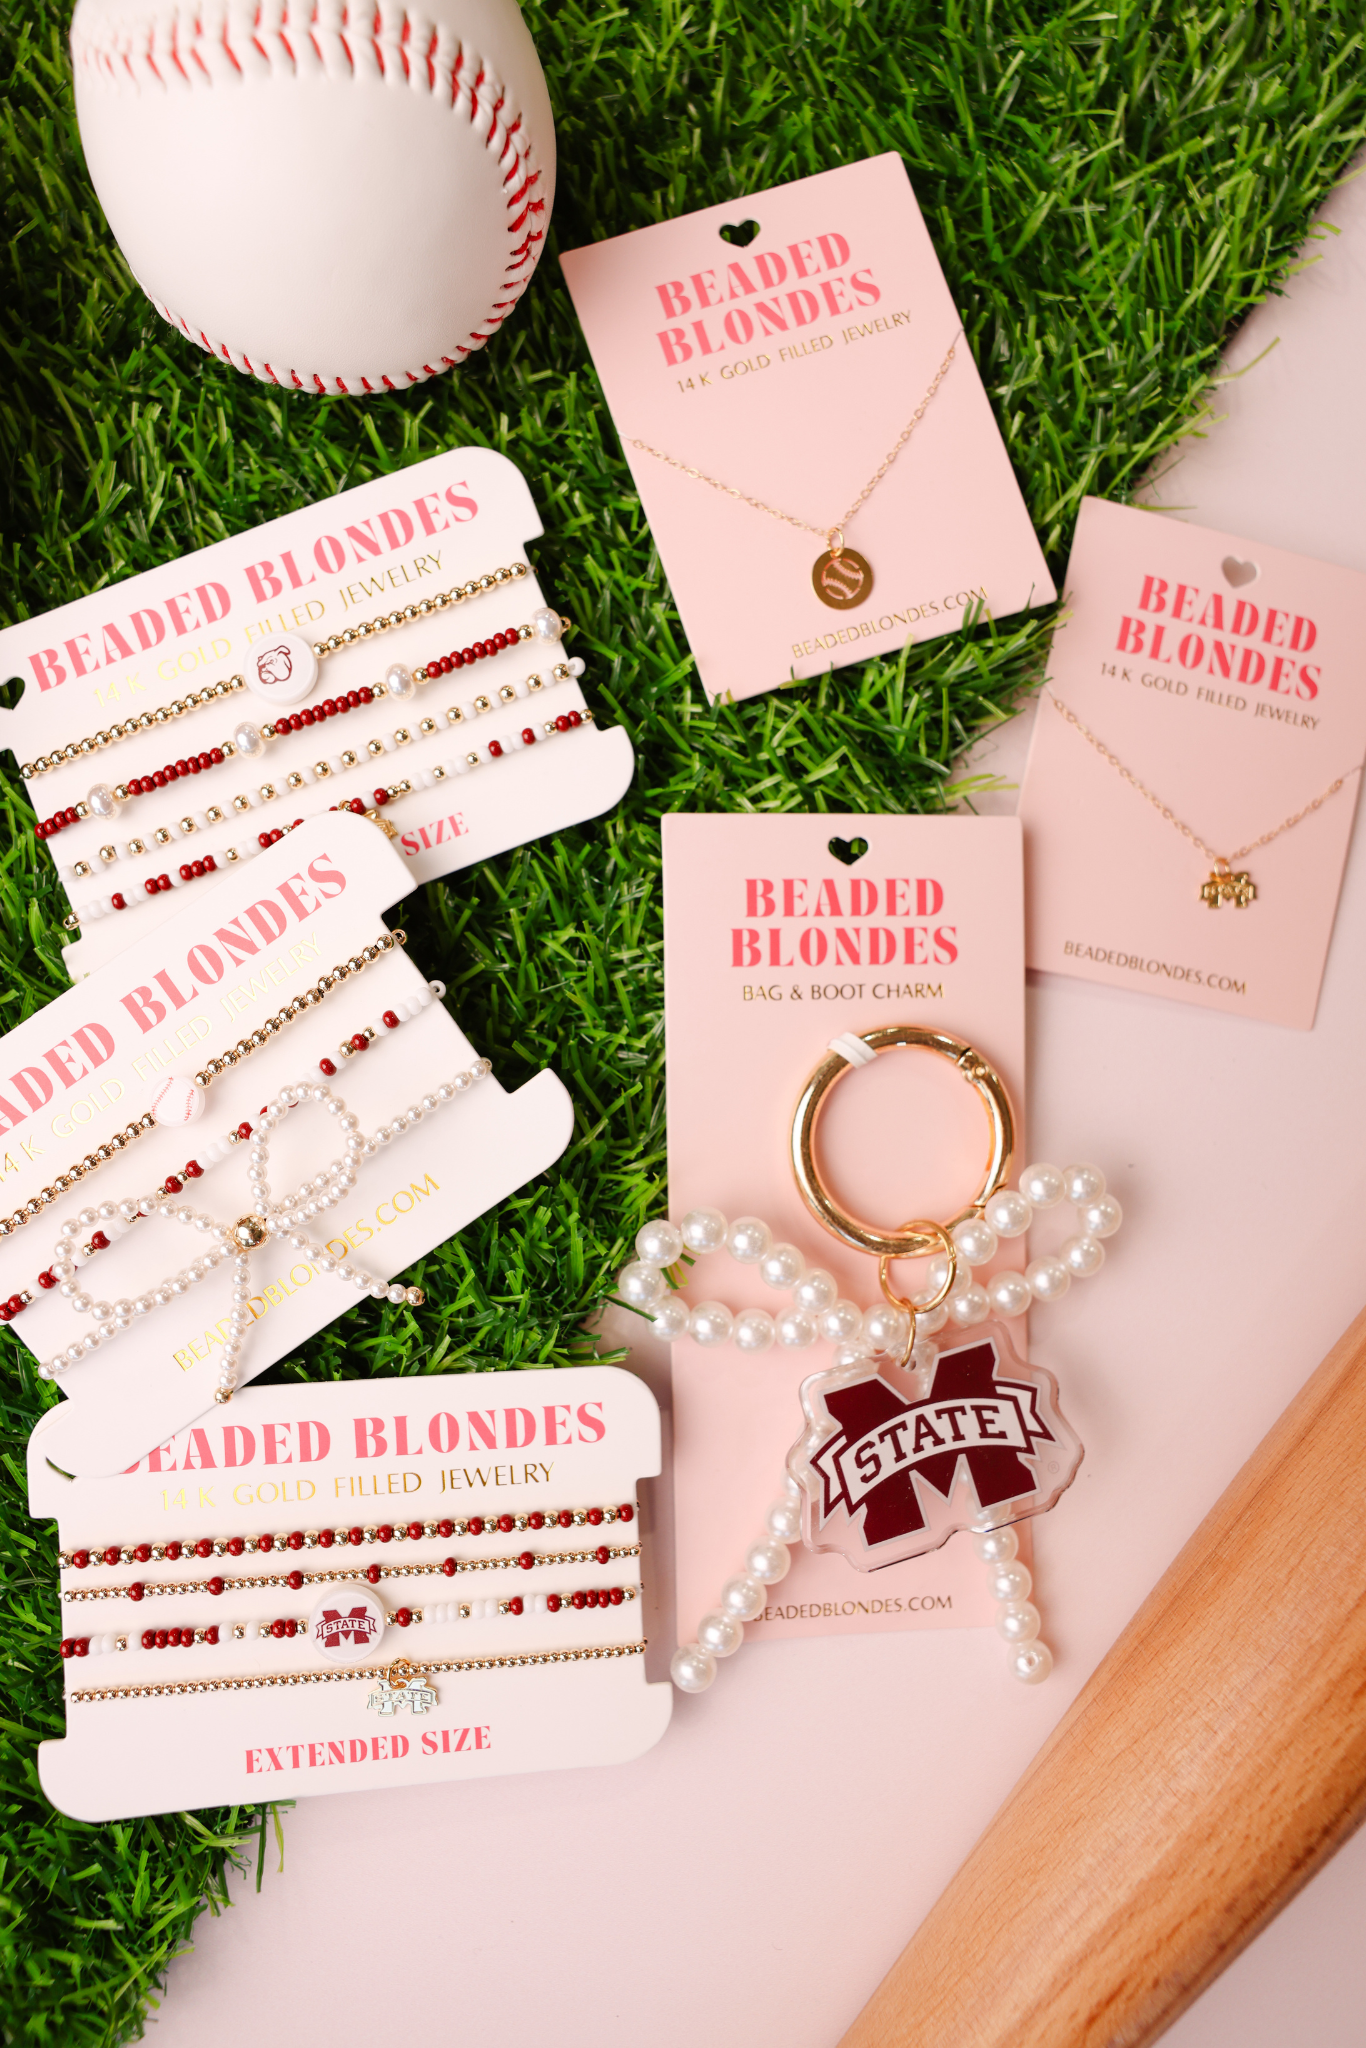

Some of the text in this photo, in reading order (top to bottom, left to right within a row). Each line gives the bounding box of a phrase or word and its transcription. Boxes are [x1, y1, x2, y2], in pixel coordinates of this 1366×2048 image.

[654, 232, 851, 320] BEADED
[655, 268, 881, 367] BLONDES
[720, 354, 771, 380] GOLD
[778, 334, 834, 362] FILLED
[841, 310, 912, 346] JEWELRY
[27, 480, 479, 692] BEADED BLONDES
[157, 638, 233, 682] GOLD
[244, 599, 326, 645] FILLED
[339, 549, 443, 613] JEWELRY
[791, 586, 988, 659] BEADEDBLONDES.COM
[1138, 574, 1317, 653] BEADED
[1115, 615, 1321, 701] BLONDES
[1140, 672, 1188, 697] GOLD
[1196, 687, 1247, 712] FILLED
[1254, 702, 1321, 731] JEWELRY
[400, 812, 469, 856] SIZE
[744, 877, 944, 918] BEADED
[119, 852, 347, 1035] BLONDES
[730, 925, 959, 968] BLONDES
[1063, 940, 1247, 996] BEADEDBLONDES.COM
[742, 982, 945, 1002] BAG & BOOT CHARM
[51, 1078, 125, 1138] GOLD
[131, 1015, 213, 1082] FILLED
[220, 931, 323, 1023] JEWELRY
[172, 1173, 441, 1372] BEADDBLODES.COM
[119, 1400, 607, 1474] EADED BLONDES
[854, 1404, 1007, 1485] STATE
[232, 1479, 316, 1506] GOLD
[334, 1470, 423, 1499] FILLED
[439, 1461, 556, 1496] JEWELRY
[326, 1619, 366, 1634] STATE
[244, 1724, 492, 1775] EXTENDED SIZE
